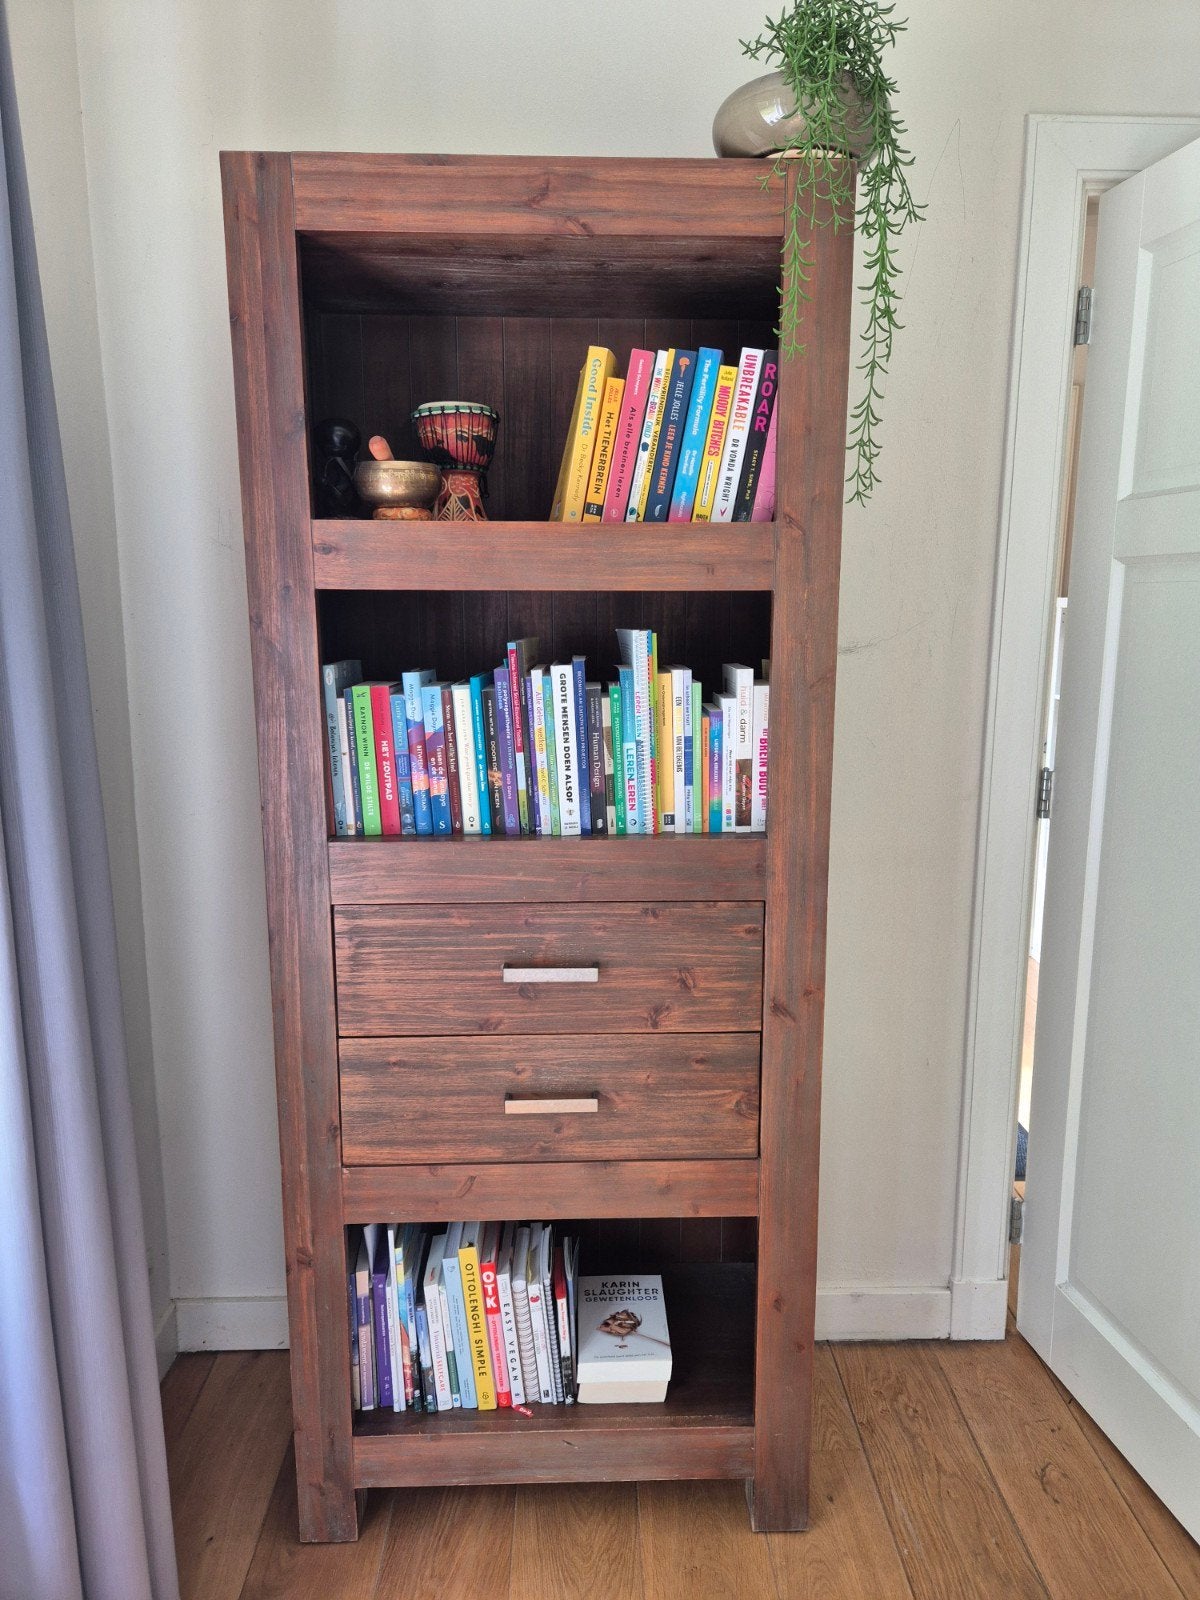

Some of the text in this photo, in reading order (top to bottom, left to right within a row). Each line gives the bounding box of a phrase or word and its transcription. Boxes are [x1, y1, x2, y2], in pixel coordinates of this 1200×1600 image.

[582, 358, 602, 437] Good Inside
[670, 380, 684, 421] JELLE JOLLES
[697, 374, 708, 404] Fertility
[715, 385, 731, 417] MOODY
[733, 354, 757, 432] UNBREAKABLE
[754, 363, 777, 432] ROAR
[605, 412, 614, 428] Het
[625, 423, 634, 438] alle
[644, 421, 653, 438] CHILD
[692, 405, 703, 436] Formula
[647, 430, 659, 474] VERANDEREN
[708, 420, 725, 457] BITCHES
[577, 454, 586, 472] Becky
[594, 429, 611, 494] TIENERBREIN
[619, 441, 631, 474] breinen
[657, 424, 676, 495] LEER JE KIND KENNEN
[722, 439, 739, 502] DR VONDA WRIGHT
[573, 474, 583, 502] Kennedy
[616, 476, 624, 498] leren
[408, 684, 416, 705] Maggie
[740, 686, 748, 706] huid
[536, 707, 544, 726] delen
[562, 706, 570, 744] MENSEN
[740, 719, 748, 743] darm
[436, 745, 444, 765] Tussen
[592, 732, 600, 760] Human
[364, 762, 370, 770] DE
[383, 761, 393, 800] ZOUTPAD
[438, 767, 444, 775] de
[593, 762, 602, 788] Design
[565, 774, 573, 803] ALSOF
[482, 1271, 498, 1309] OTK
[584, 1288, 659, 1297] SLAUGHTER
[465, 1263, 487, 1377] OTTOLENGHI SIMPLE
[492, 1320, 500, 1352] OTTOLENGHI
[504, 1303, 519, 1382] EASY VEGAN
[437, 1360, 446, 1392] SELFCARE
